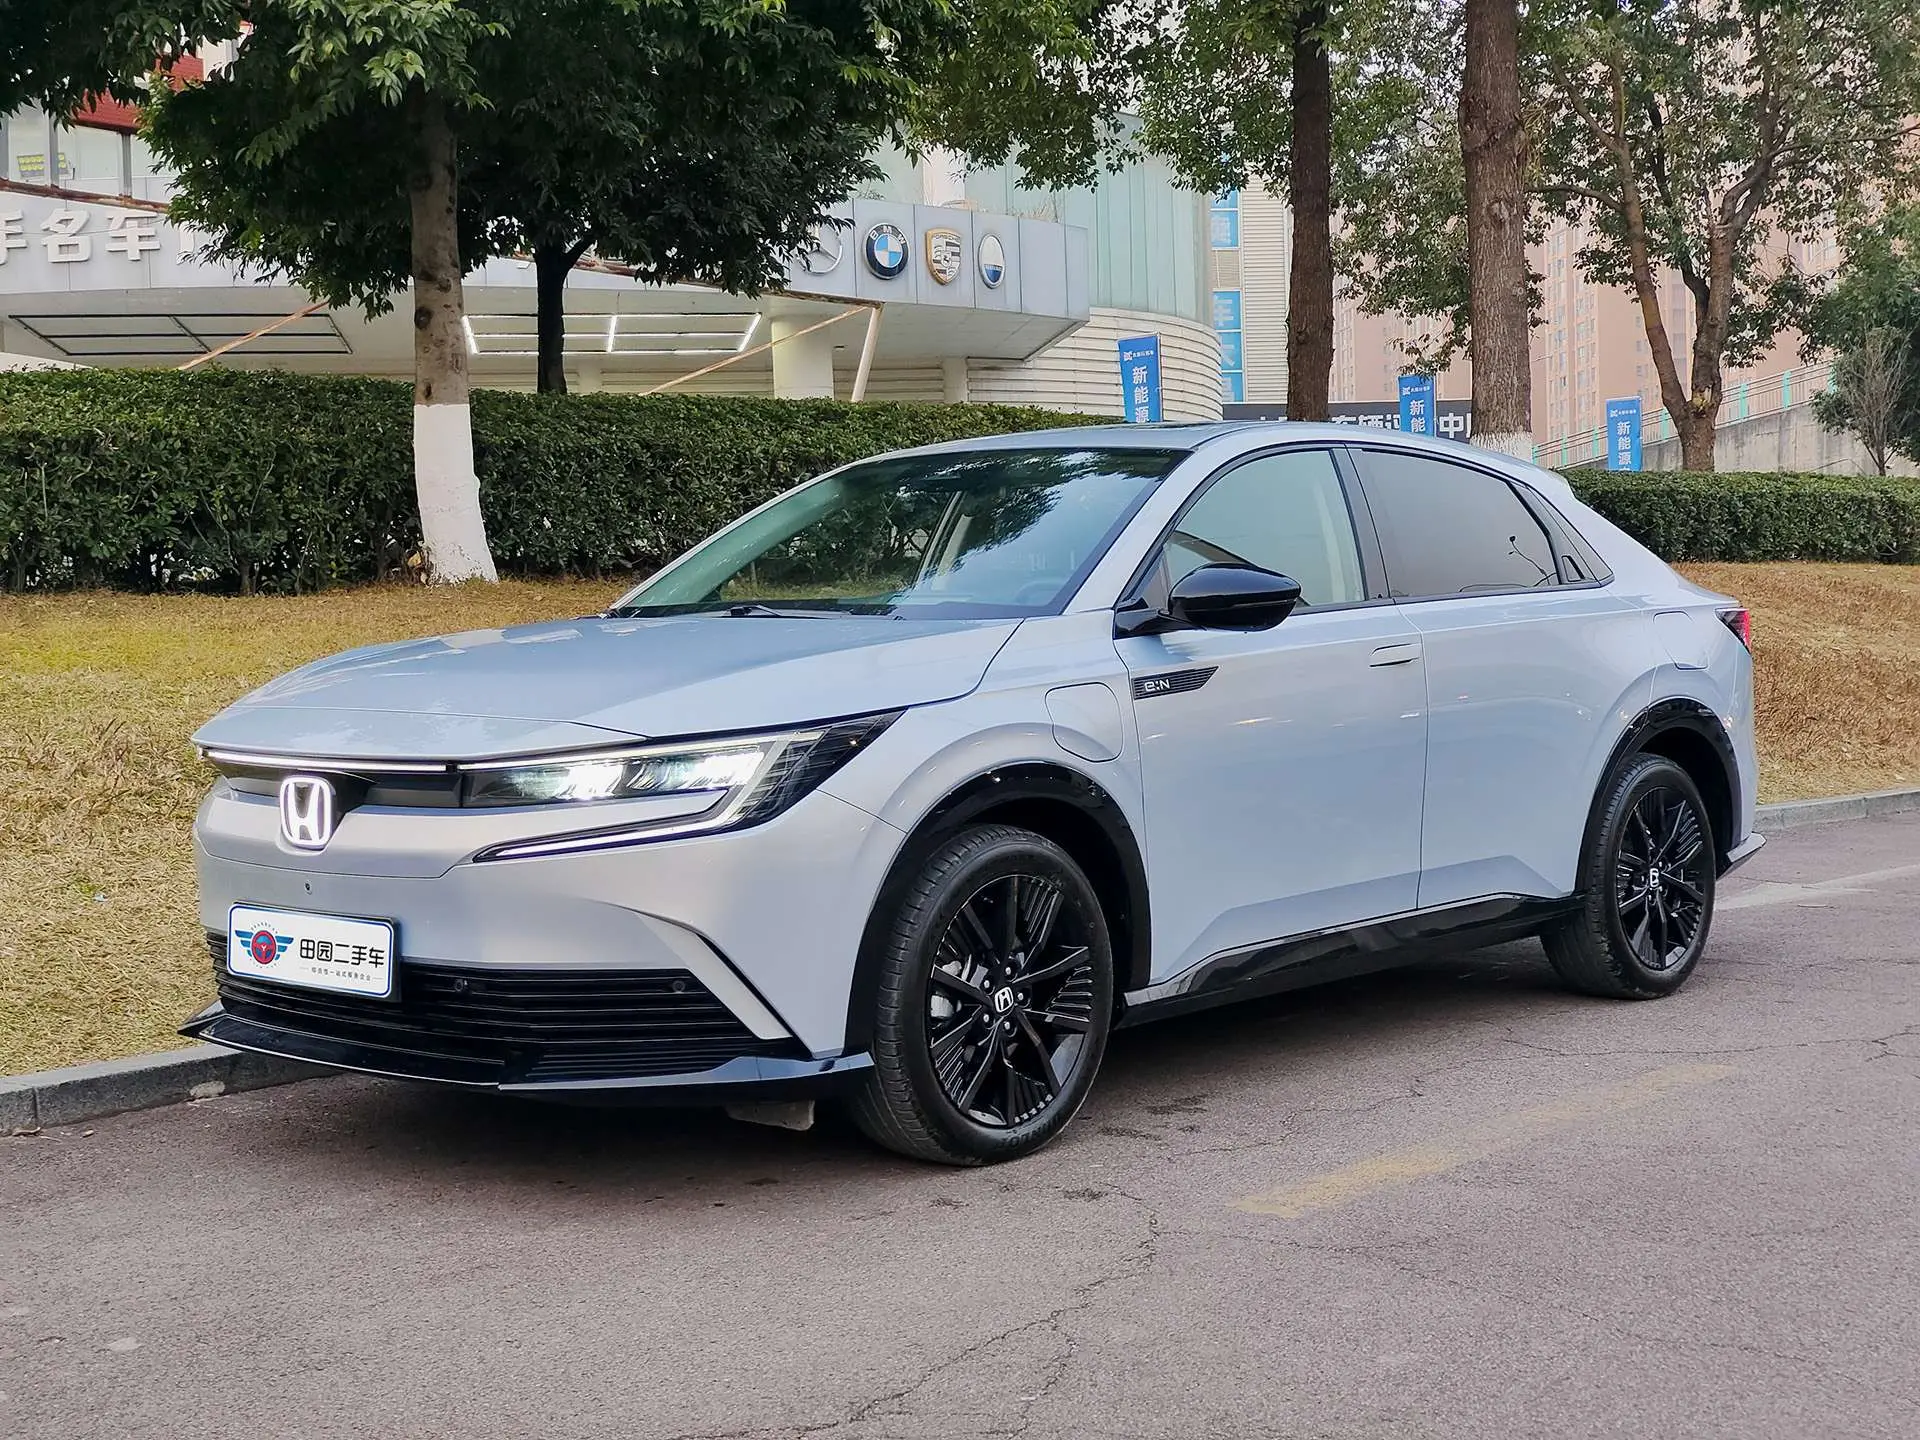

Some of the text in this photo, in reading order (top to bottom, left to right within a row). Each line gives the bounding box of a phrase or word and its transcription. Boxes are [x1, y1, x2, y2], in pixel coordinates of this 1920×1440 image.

[869, 225, 906, 245] BMW
[1132, 366, 1150, 422] 新能源
[1617, 421, 1632, 471] 新能源
[300, 938, 385, 968] 田园二手车
